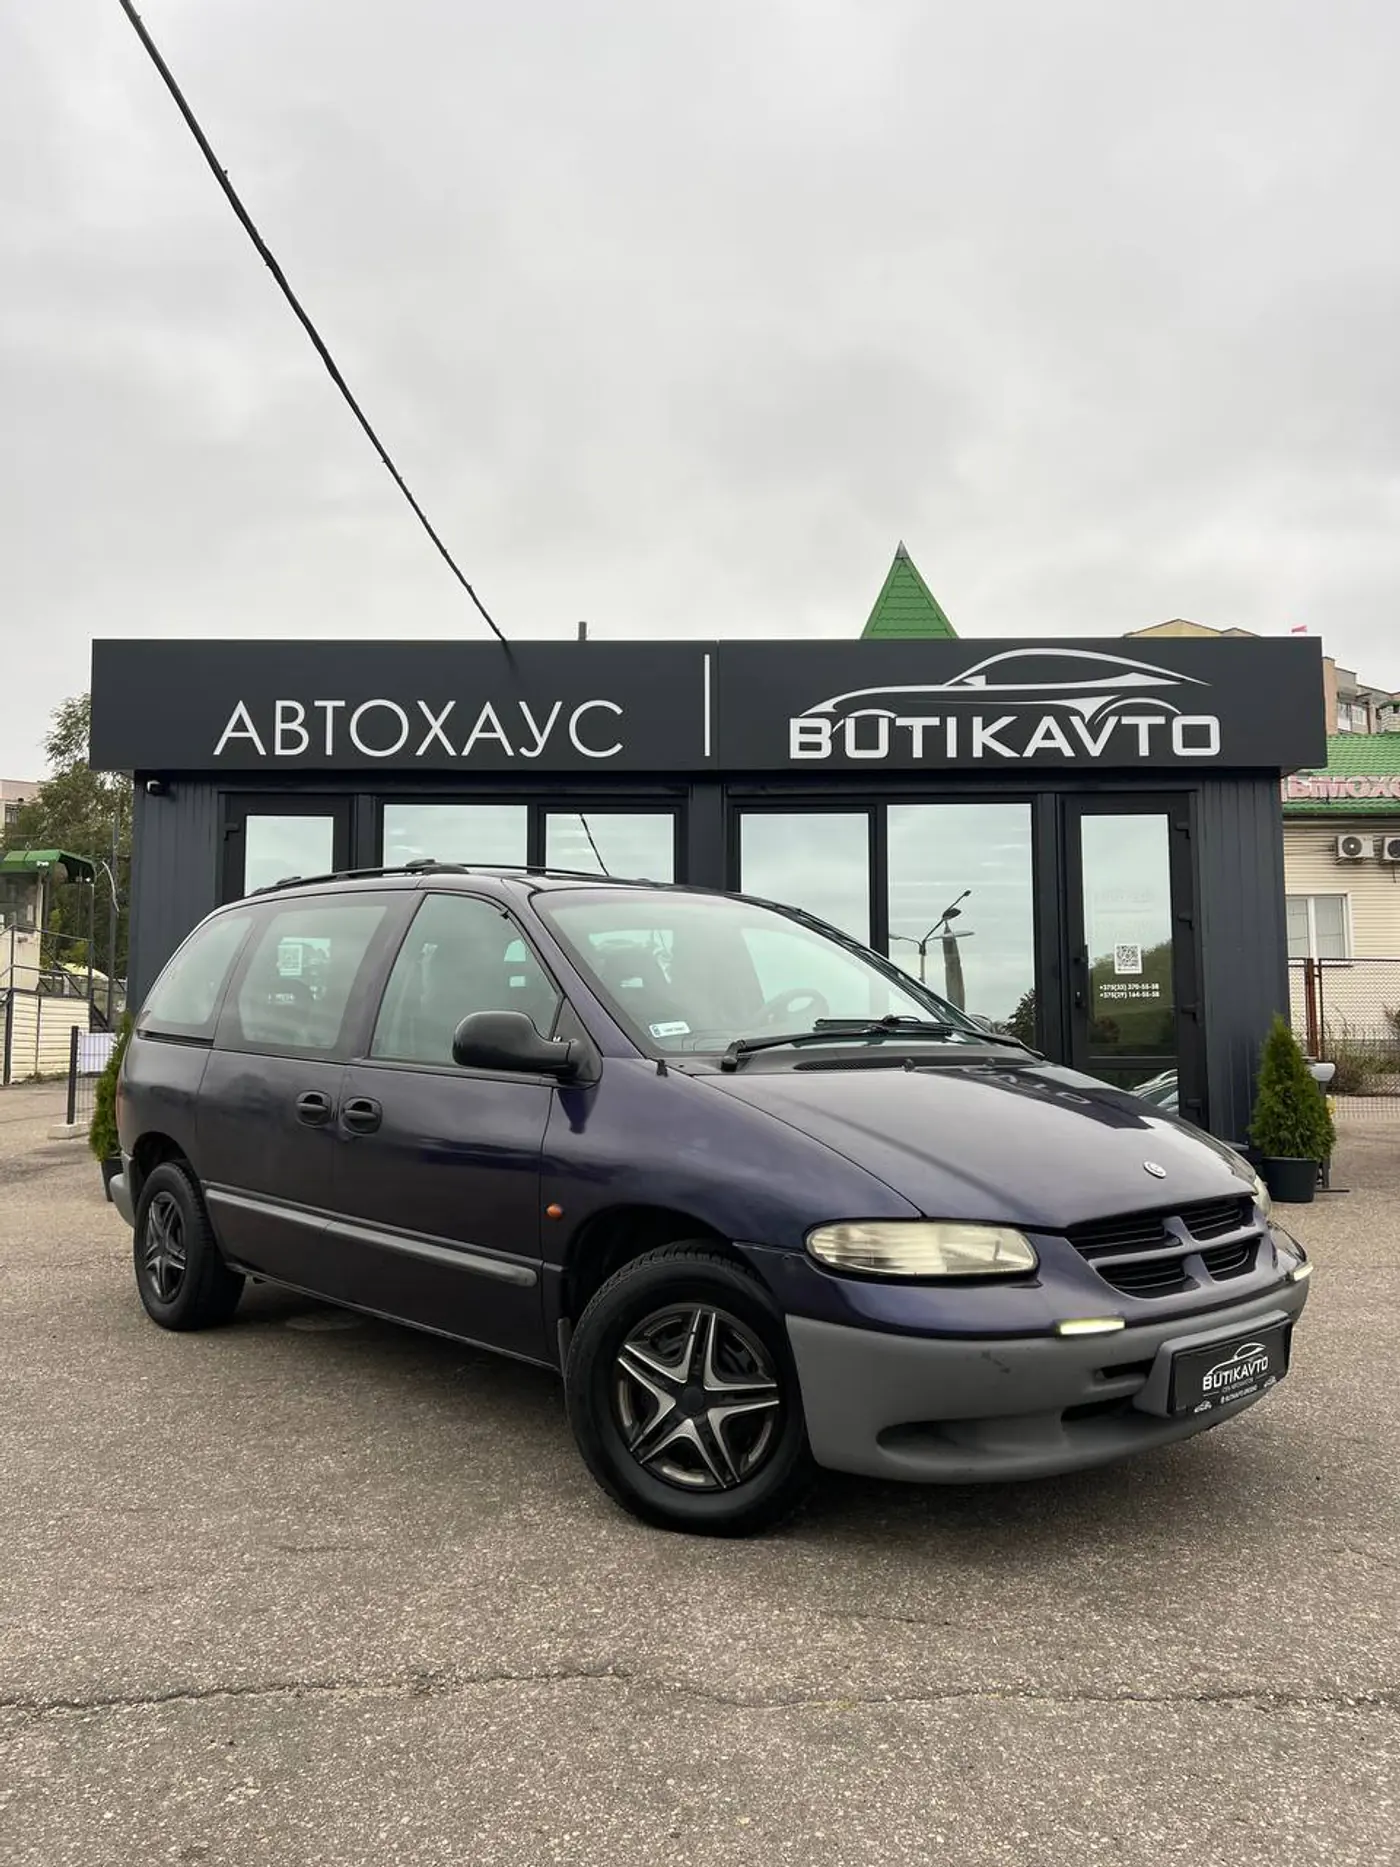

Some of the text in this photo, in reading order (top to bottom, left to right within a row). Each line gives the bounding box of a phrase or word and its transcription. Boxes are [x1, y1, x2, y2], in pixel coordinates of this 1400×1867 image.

[213, 698, 624, 758] АВТОХАУС
[789, 712, 1221, 760] BUTIKAVTO
[1202, 1356, 1268, 1391] BUTIKAVTO
